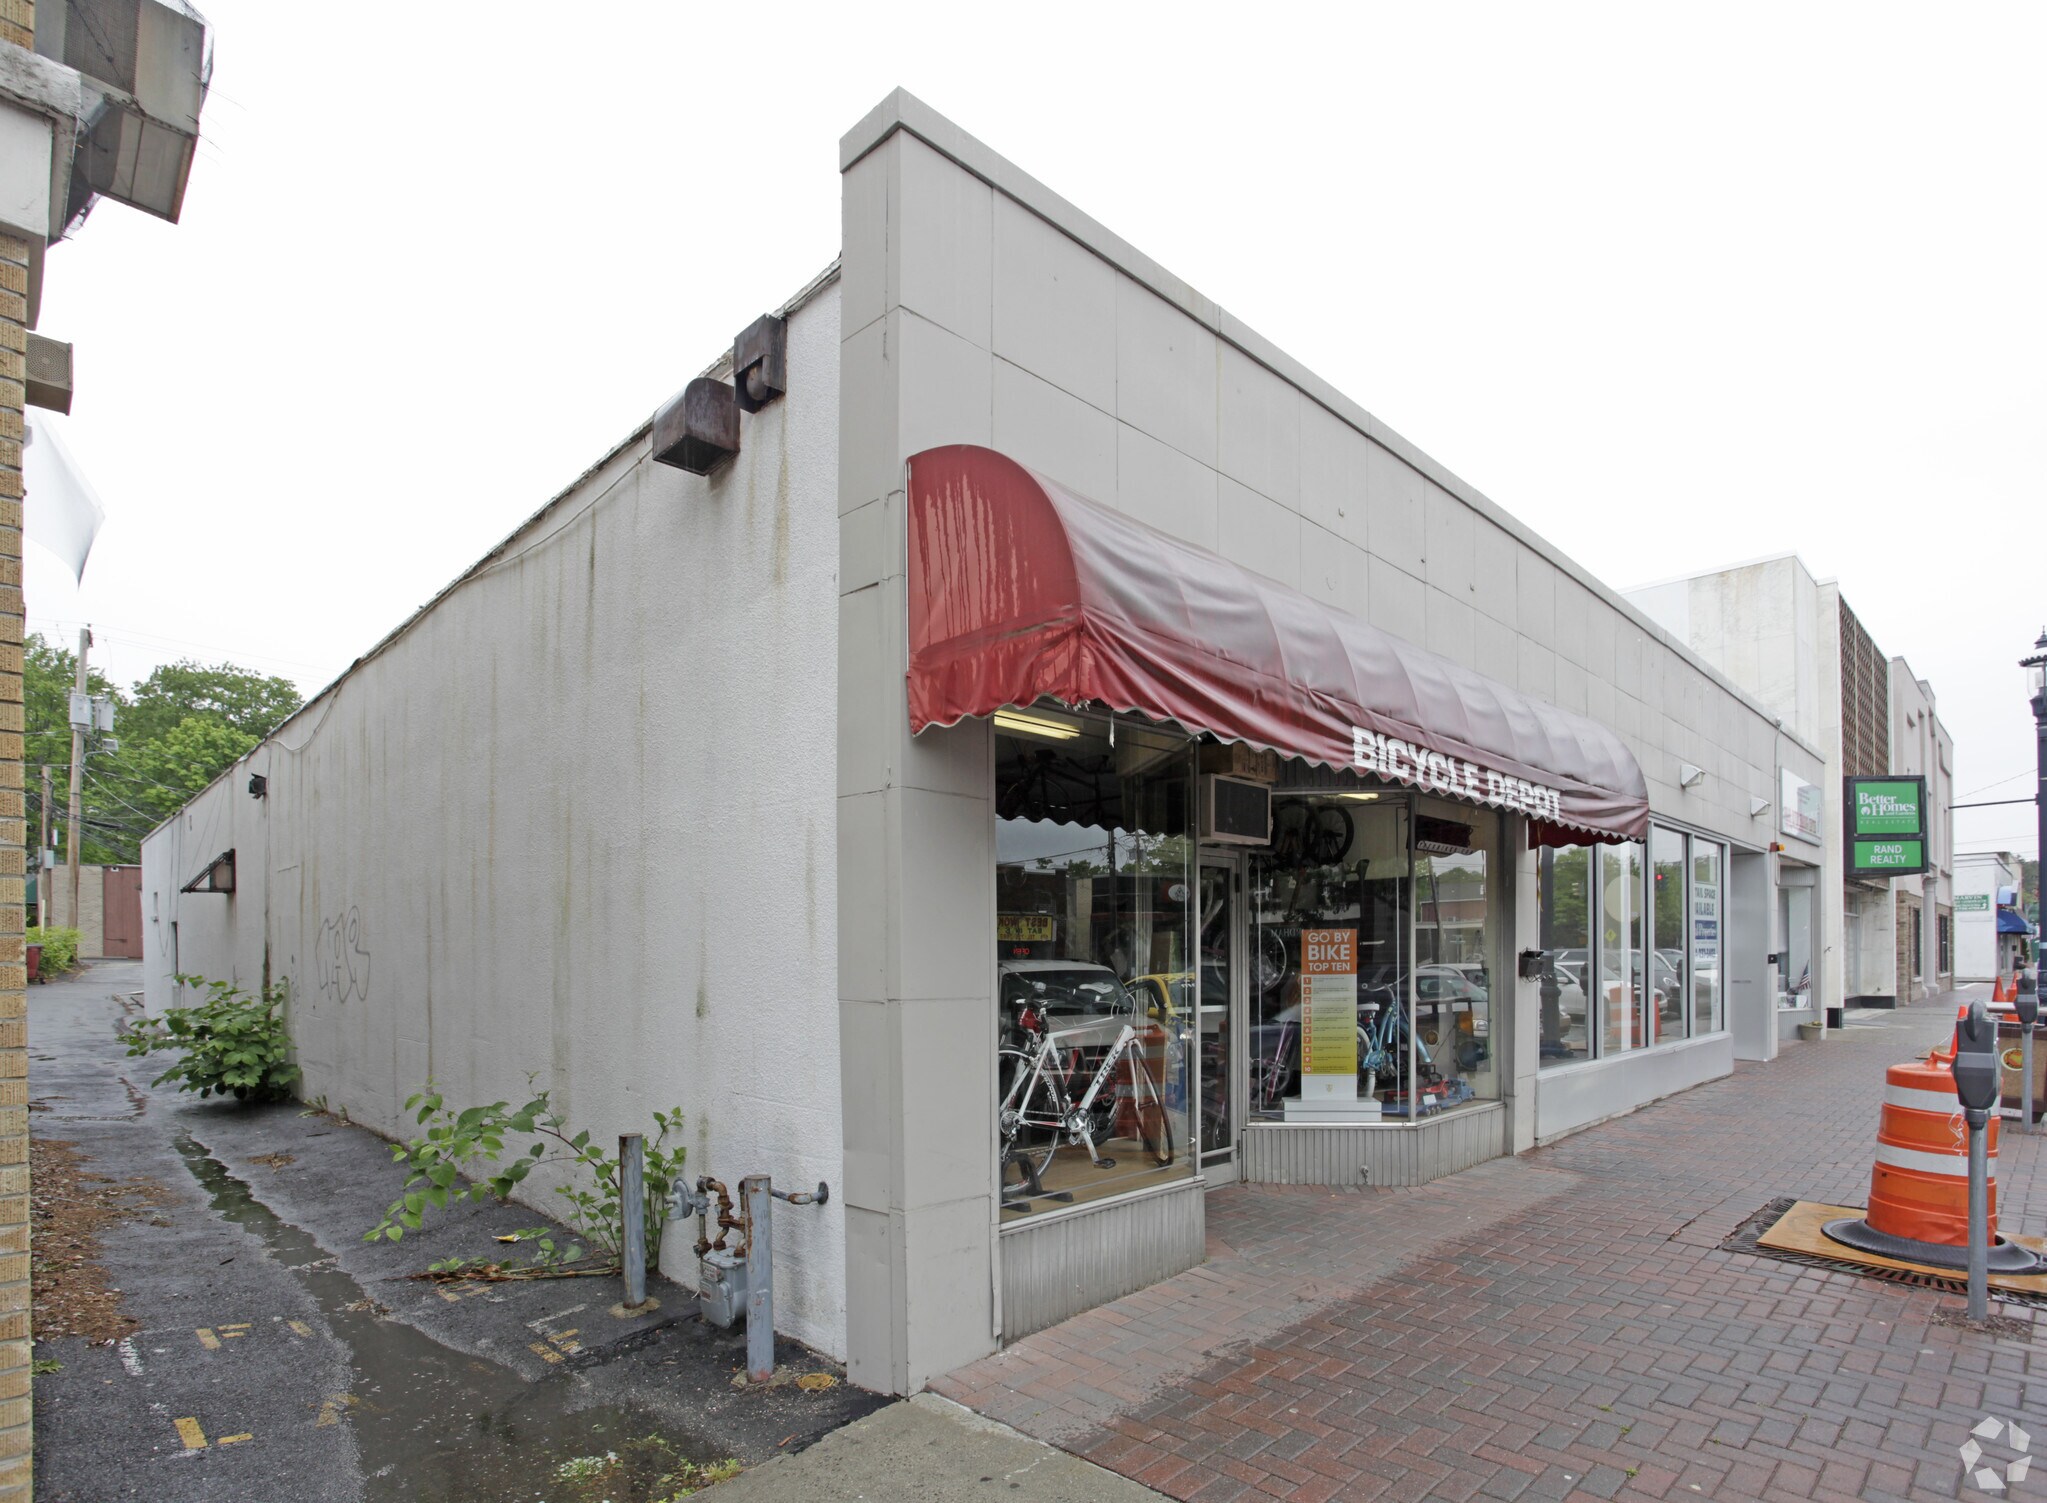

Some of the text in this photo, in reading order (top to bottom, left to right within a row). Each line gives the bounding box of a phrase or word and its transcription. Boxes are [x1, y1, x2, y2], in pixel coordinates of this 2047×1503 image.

[1352, 725, 1560, 820] BICYCLE DEPOT
[1859, 792, 1897, 805] Better
[1872, 803, 1916, 816] Homes
[1874, 844, 1902, 854] RAND
[1870, 855, 1906, 864] REALTY
[1308, 932, 1350, 943] GO BY
[1308, 944, 1350, 961] BIKE
[1308, 962, 1350, 972] TOP TEN
